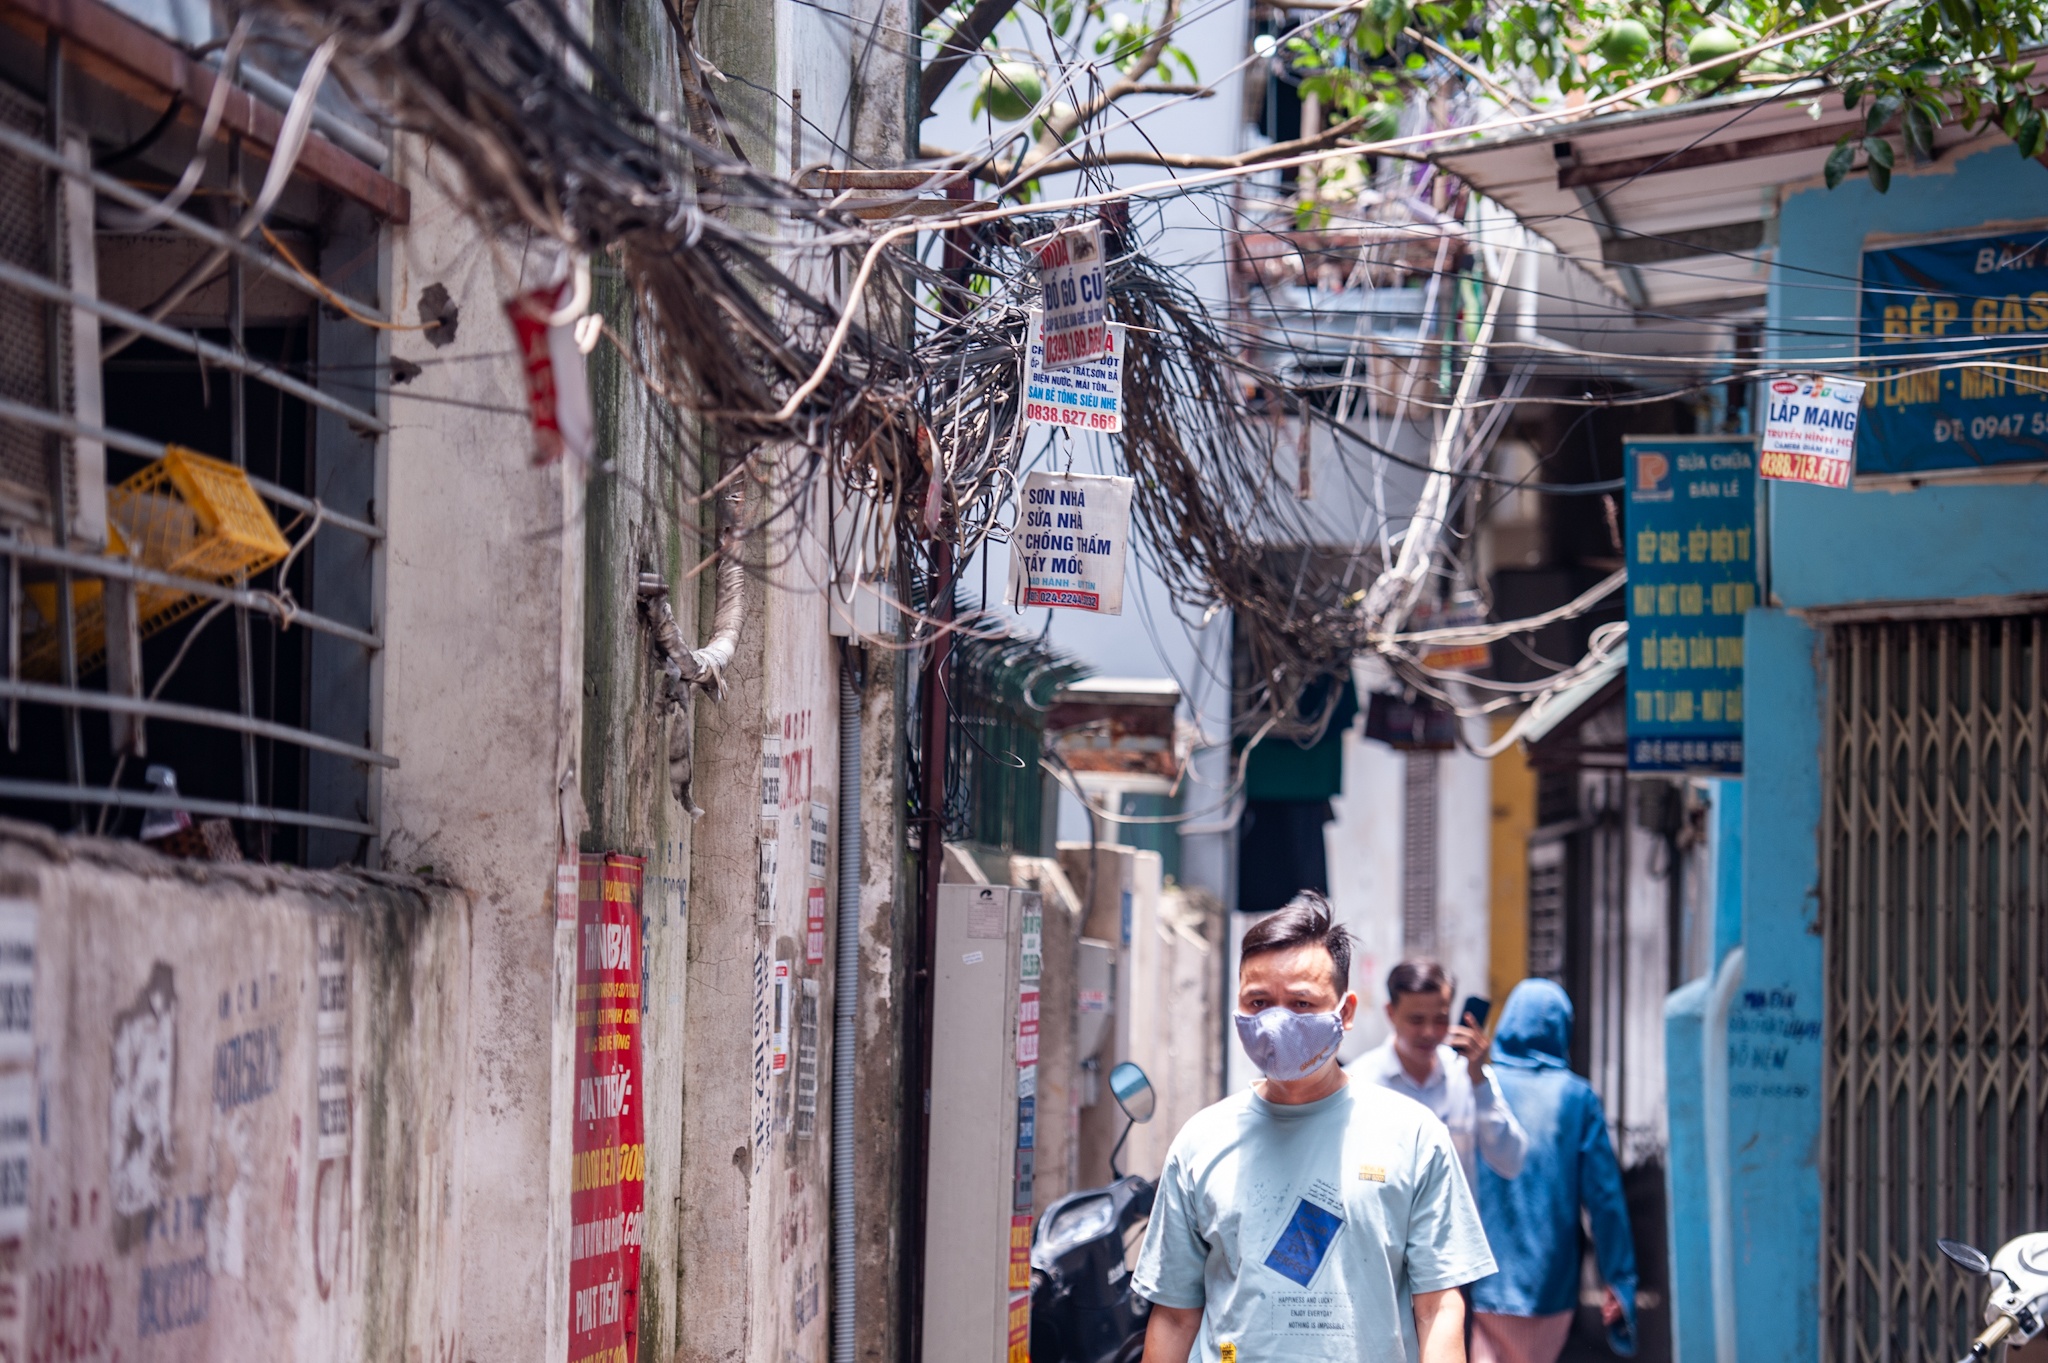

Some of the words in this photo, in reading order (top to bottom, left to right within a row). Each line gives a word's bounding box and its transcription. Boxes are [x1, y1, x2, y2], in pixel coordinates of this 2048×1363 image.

[1080, 267, 1102, 303] CŨ
[1972, 291, 2048, 335] GAS
[1046, 387, 1055, 402] BÊ
[1058, 389, 1077, 405] TÔNG
[1080, 393, 1098, 408] SIÊU
[1101, 398, 1117, 413] NHẸ
[1770, 396, 1799, 423] LẮP
[1803, 405, 1856, 431] MẠNG
[1971, 414, 2025, 440] 0947
[2032, 412, 2048, 435] 5
[1029, 488, 1055, 505] SƠN
[1060, 488, 1085, 507] NHÀ
[1027, 507, 1051, 527] SỬA
[1057, 511, 1083, 530] NHÀ
[1025, 529, 1073, 551] CHỐNG
[1077, 533, 1111, 555] THẤM
[1025, 551, 1046, 572] TẨY
[1051, 553, 1083, 575] MỐC
[1042, 576, 1069, 587] HÀNH
